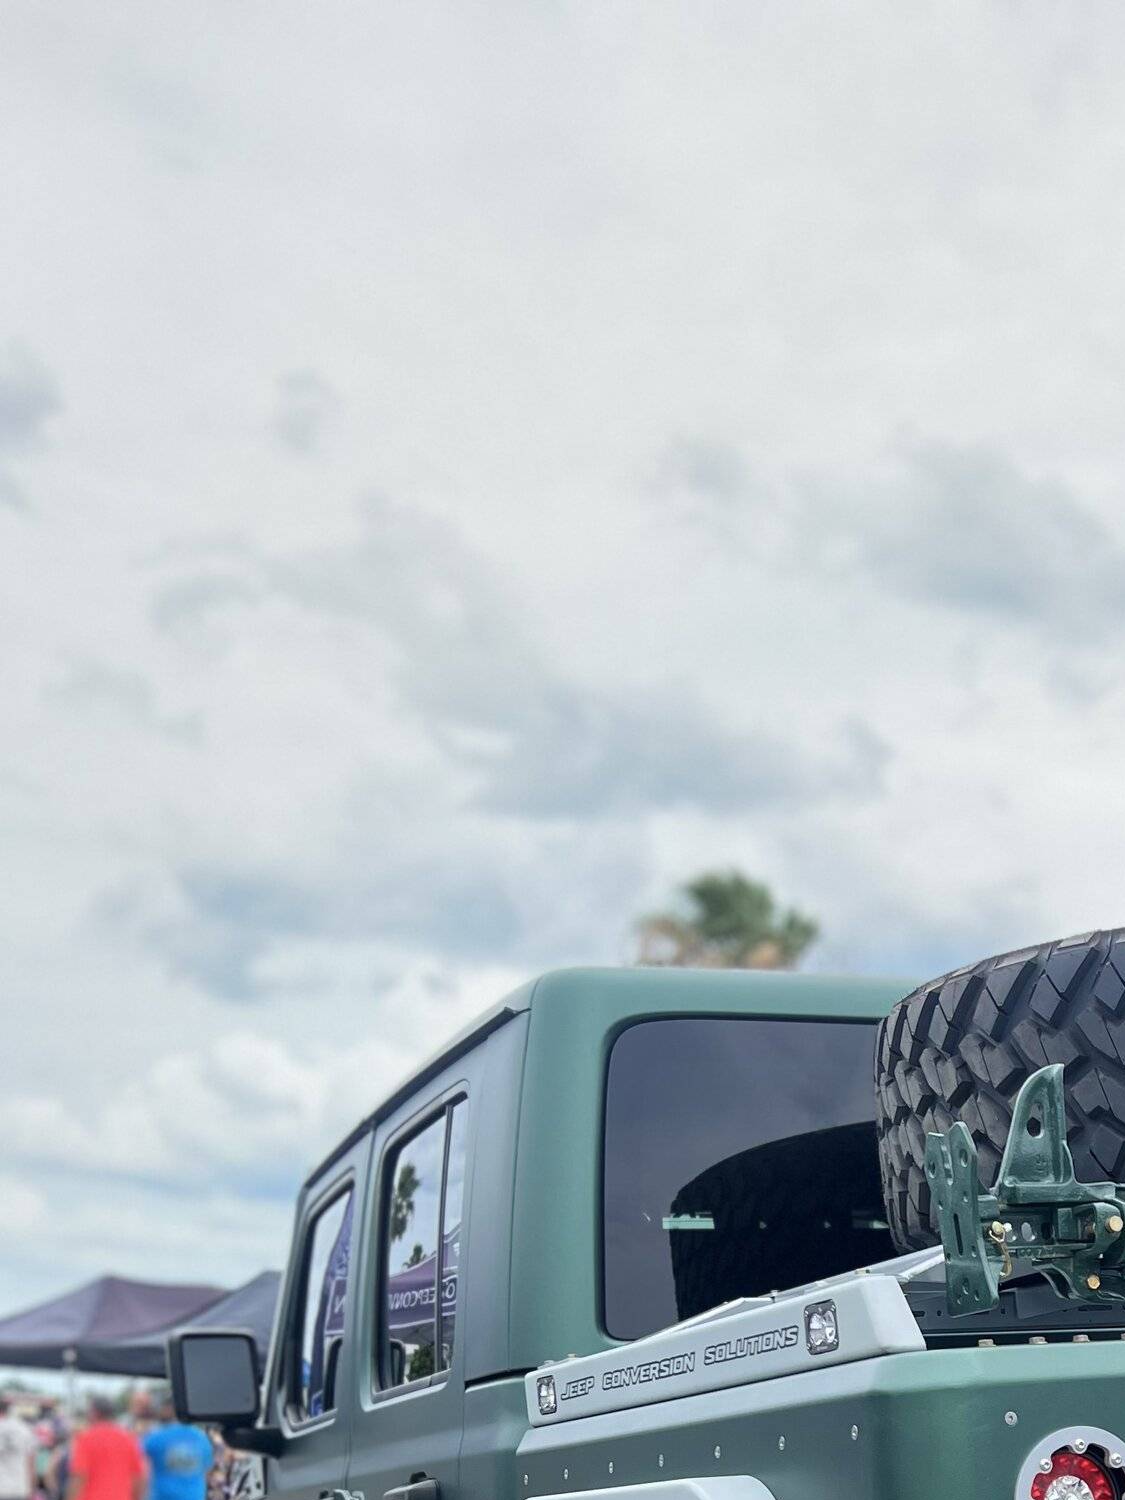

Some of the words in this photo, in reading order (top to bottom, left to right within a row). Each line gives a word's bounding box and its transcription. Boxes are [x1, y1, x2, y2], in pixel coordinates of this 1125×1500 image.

[560, 1375, 596, 1401] JEEP
[602, 1351, 696, 1391] CONVERSION
[703, 1325, 800, 1367] SOLUTIONS
